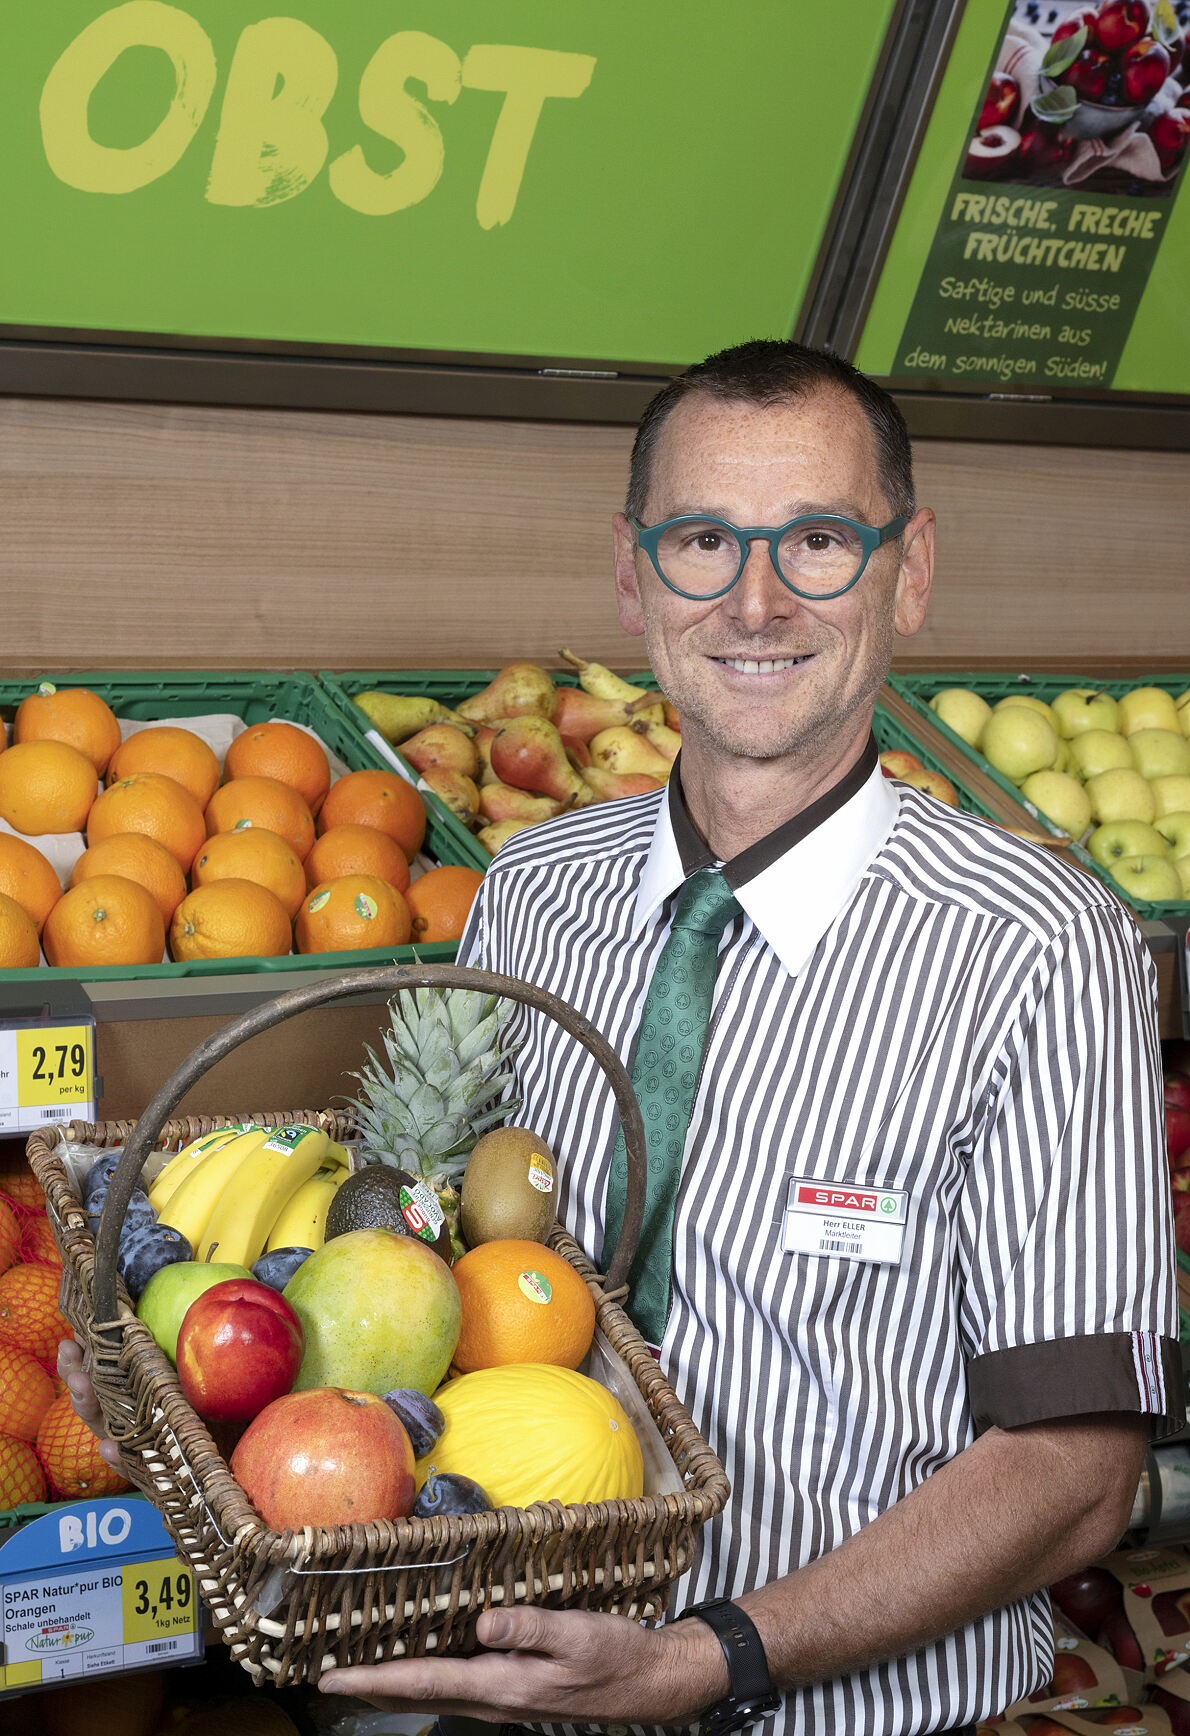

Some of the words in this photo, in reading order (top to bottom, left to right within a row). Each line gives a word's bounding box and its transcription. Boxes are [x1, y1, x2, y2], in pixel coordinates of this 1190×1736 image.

[39, 0, 597, 230] OBST
[951, 193, 1058, 233] FRISCHE,
[1068, 204, 1162, 239] FRECHE
[963, 229, 1126, 272] FRÜCHTCHEN
[939, 276, 1015, 309] Saftige
[1022, 284, 1059, 306] und
[1062, 289, 1121, 312] süsse
[944, 313, 1051, 340] Nektarinen
[1058, 326, 1091, 346] aus
[904, 347, 946, 370] dem
[952, 353, 1036, 380] sonnigen
[1044, 356, 1107, 380] Süden!
[32, 1044, 85, 1086] 2,79
[59, 1087, 73, 1095] per
[74, 1084, 85, 1094] kg
[815, 1192, 876, 1209] SPAR
[823, 1219, 840, 1229] Herr
[842, 1221, 866, 1232] ELLER
[59, 1508, 132, 1553] BIO
[5, 1588, 39, 1604] SPAR
[102, 1575, 123, 1589] BIO
[135, 1573, 191, 1619] 3,49
[5, 1603, 56, 1620] Orangen
[5, 1622, 35, 1633] Schale
[37, 1612, 91, 1628] unbehandelt
[155, 1618, 170, 1628] 1kg
[173, 1615, 191, 1625] Netz
[60, 1668, 65, 1679] 1
